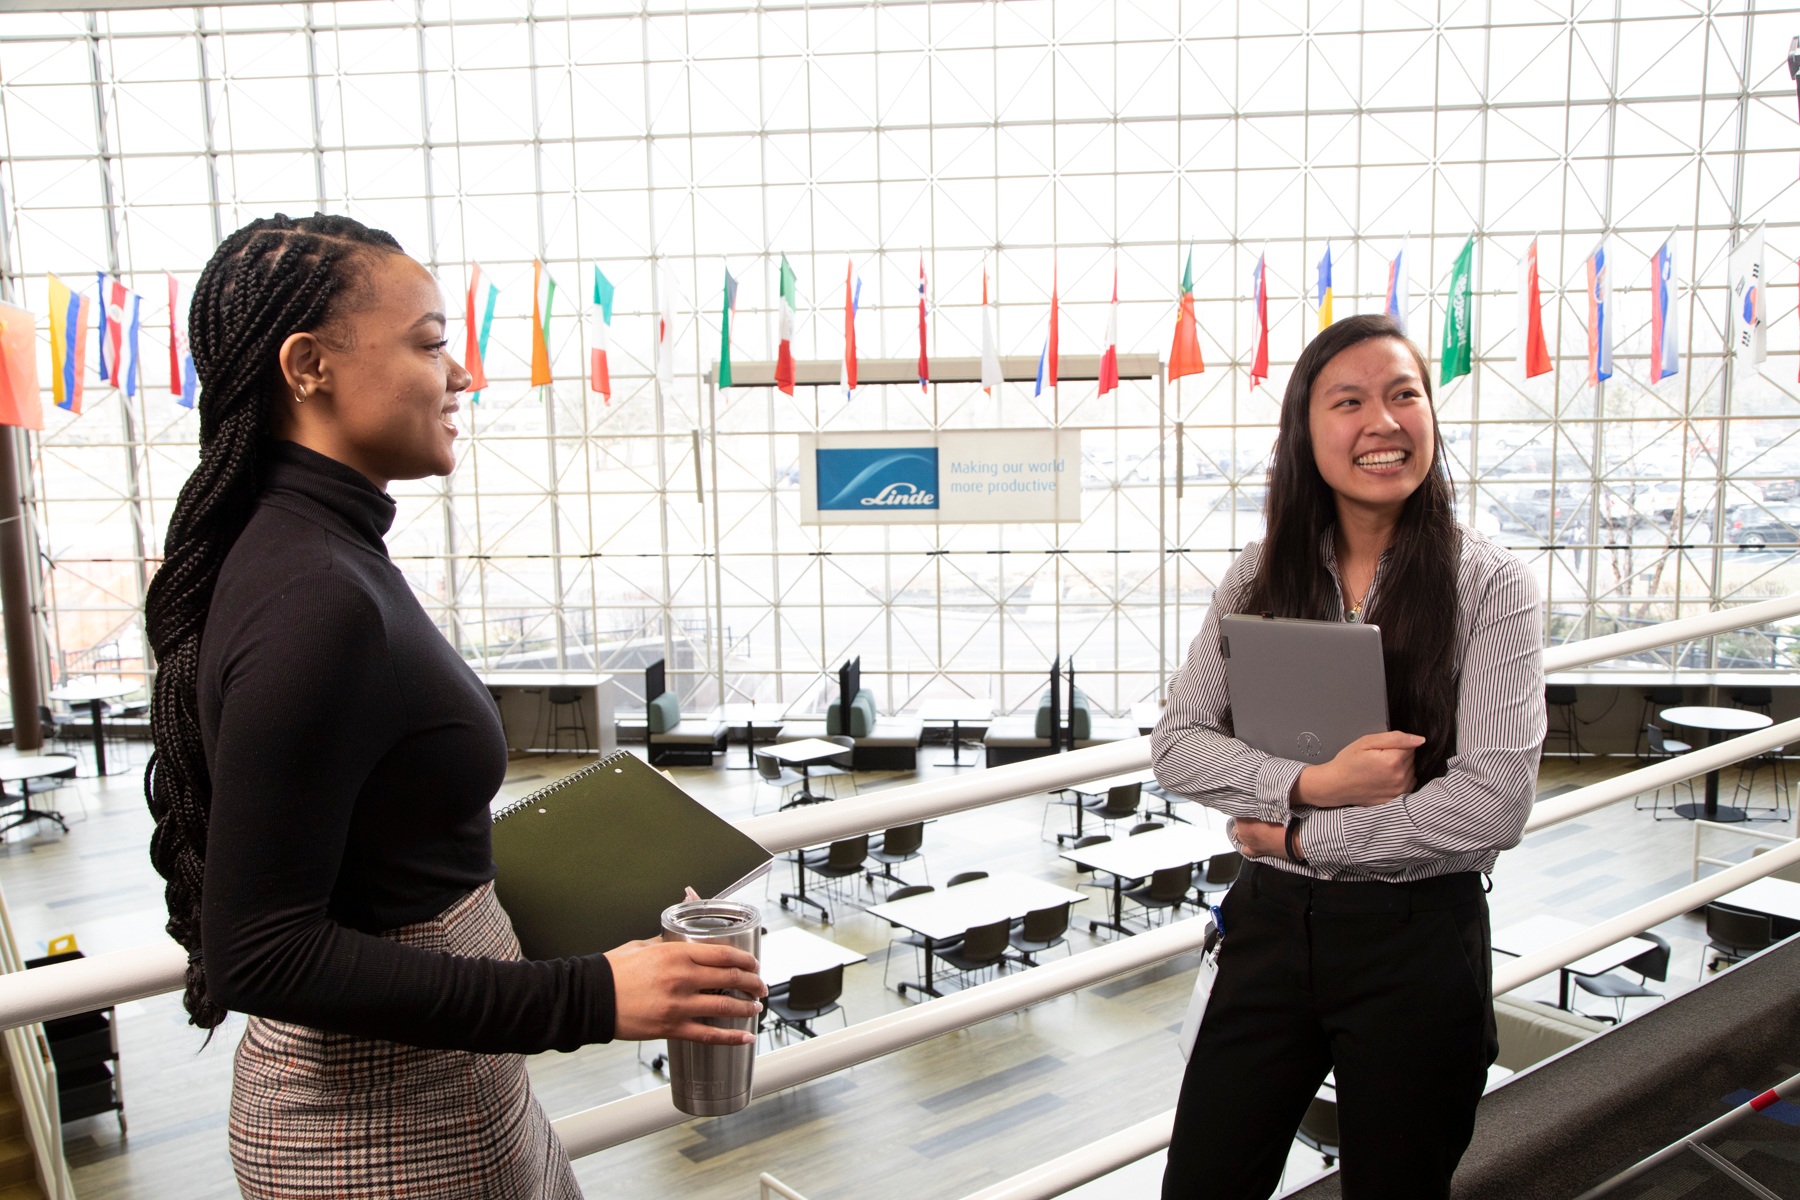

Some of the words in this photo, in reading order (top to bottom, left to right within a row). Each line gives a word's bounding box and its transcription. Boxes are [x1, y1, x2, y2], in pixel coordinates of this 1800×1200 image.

[951, 460, 998, 476] Making
[1002, 463, 1023, 473] our
[1028, 459, 1065, 473] world
[860, 482, 934, 505] Linde
[950, 480, 983, 492] more
[988, 479, 1056, 495] productive
